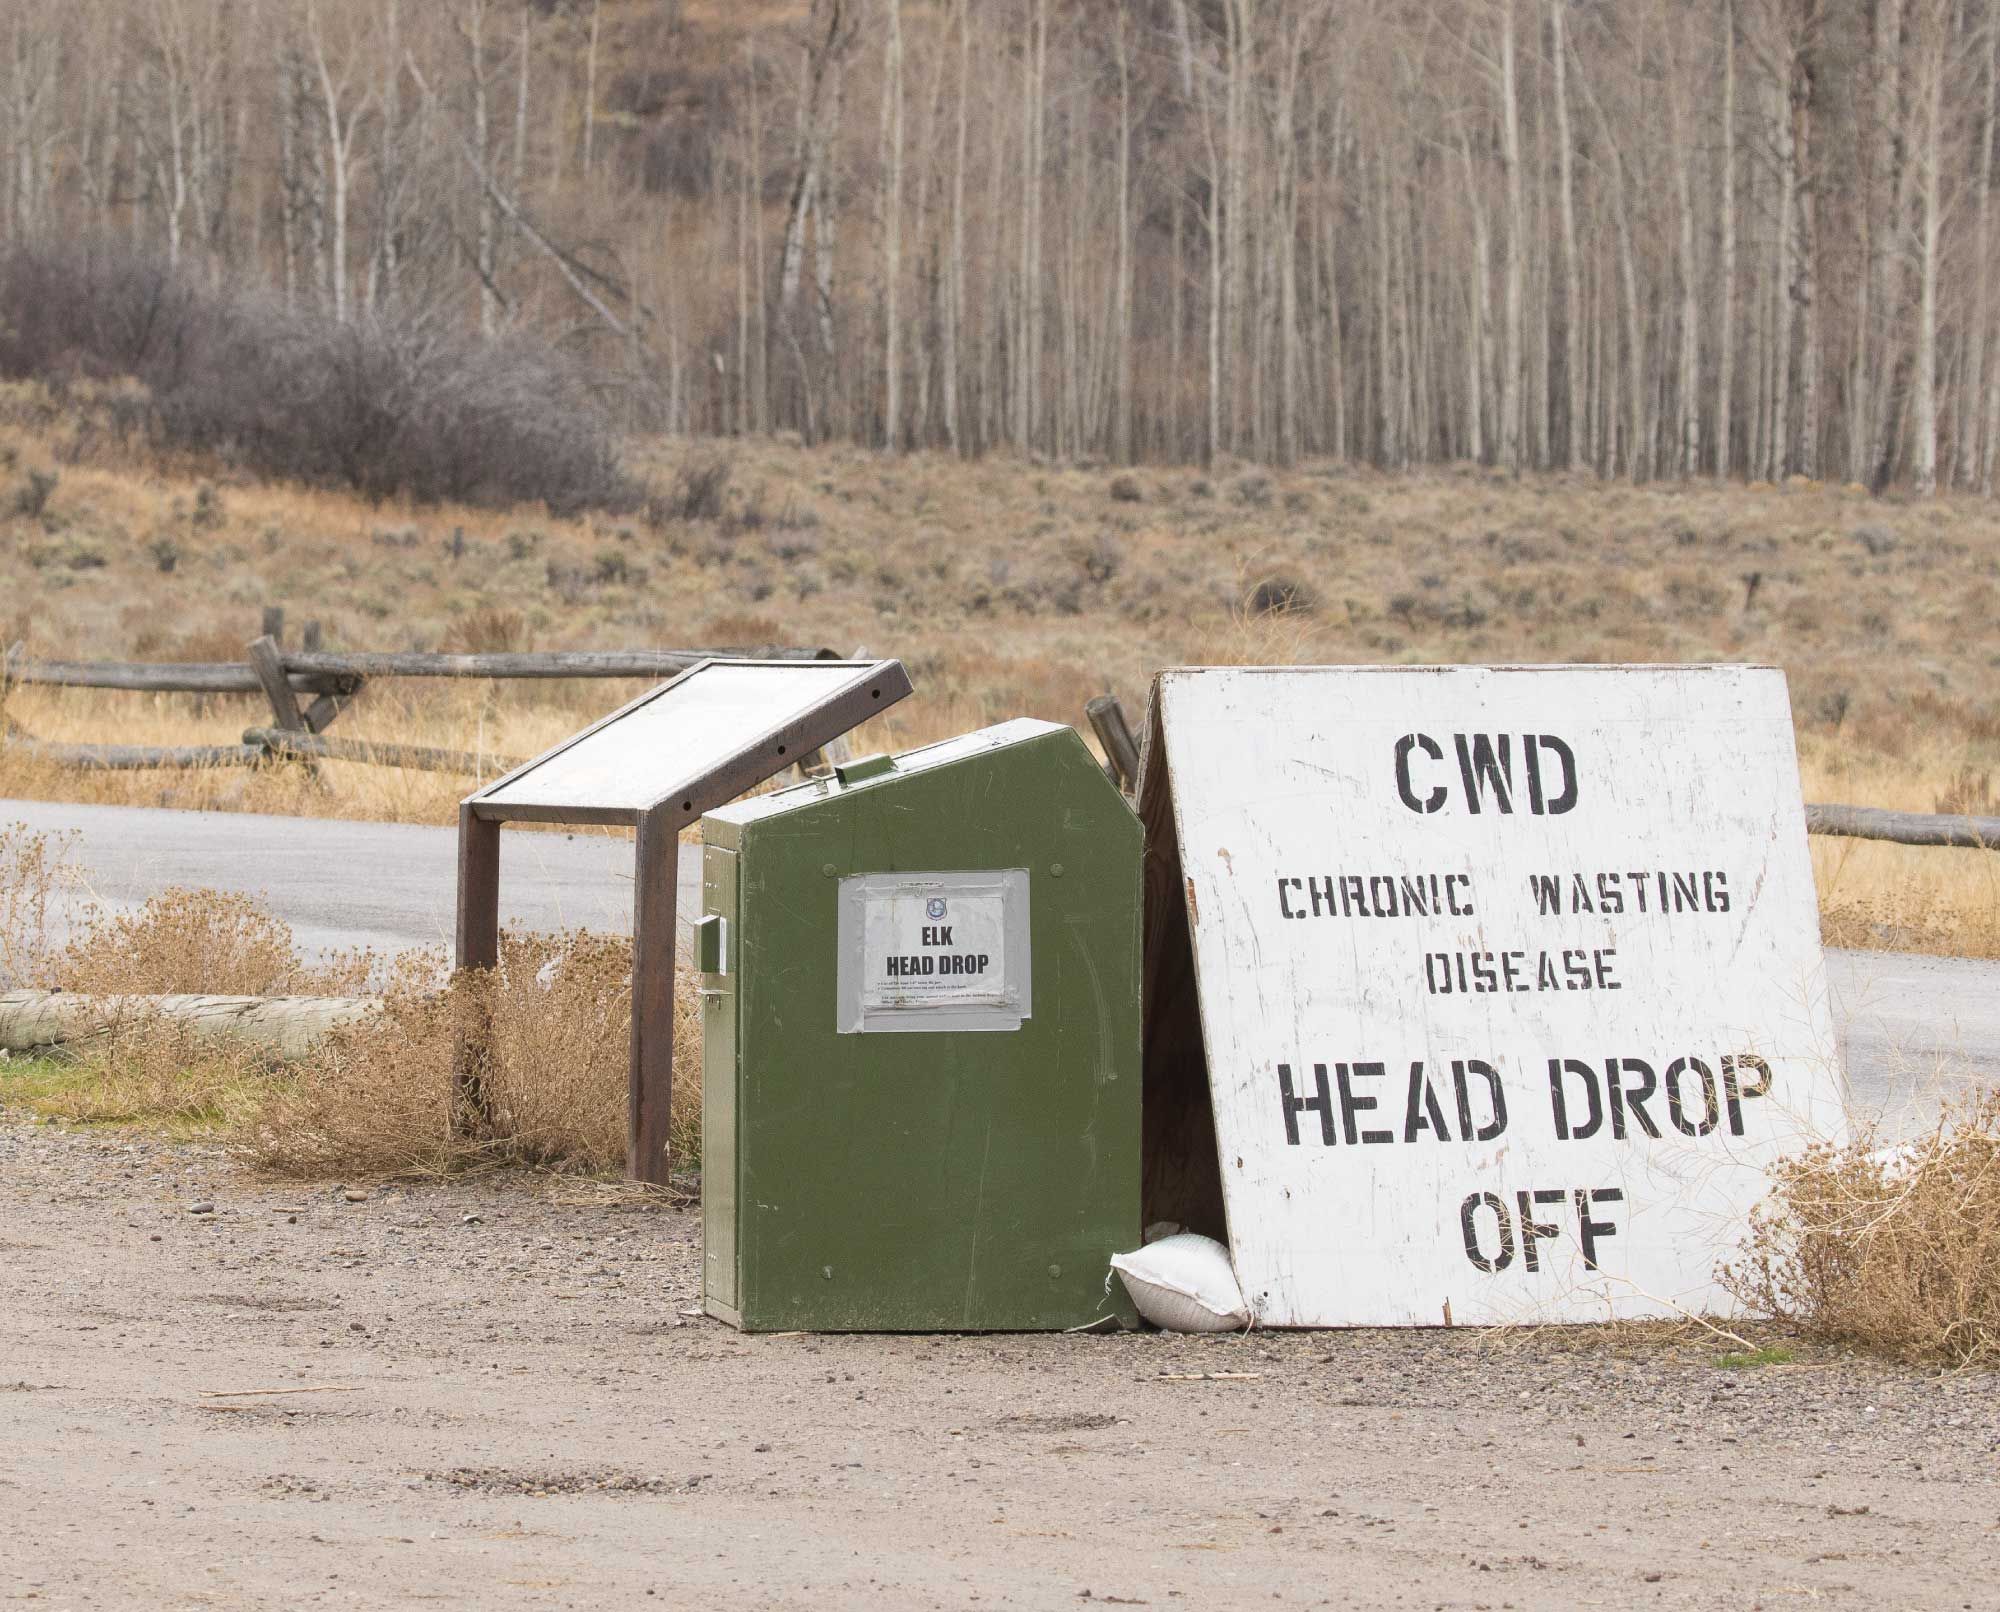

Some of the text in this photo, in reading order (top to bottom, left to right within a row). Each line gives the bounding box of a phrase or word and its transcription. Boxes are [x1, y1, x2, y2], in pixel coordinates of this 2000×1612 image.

[1394, 733, 1579, 815] CWD
[1278, 871, 1731, 919] CHRONIC WASTING
[921, 926, 953, 946] ELK
[886, 954, 989, 976] HEAD DROP
[1425, 949, 1622, 995] DISEASE
[1277, 1054, 1773, 1146] HEAD DROP
[1460, 1188, 1624, 1274] OFF
